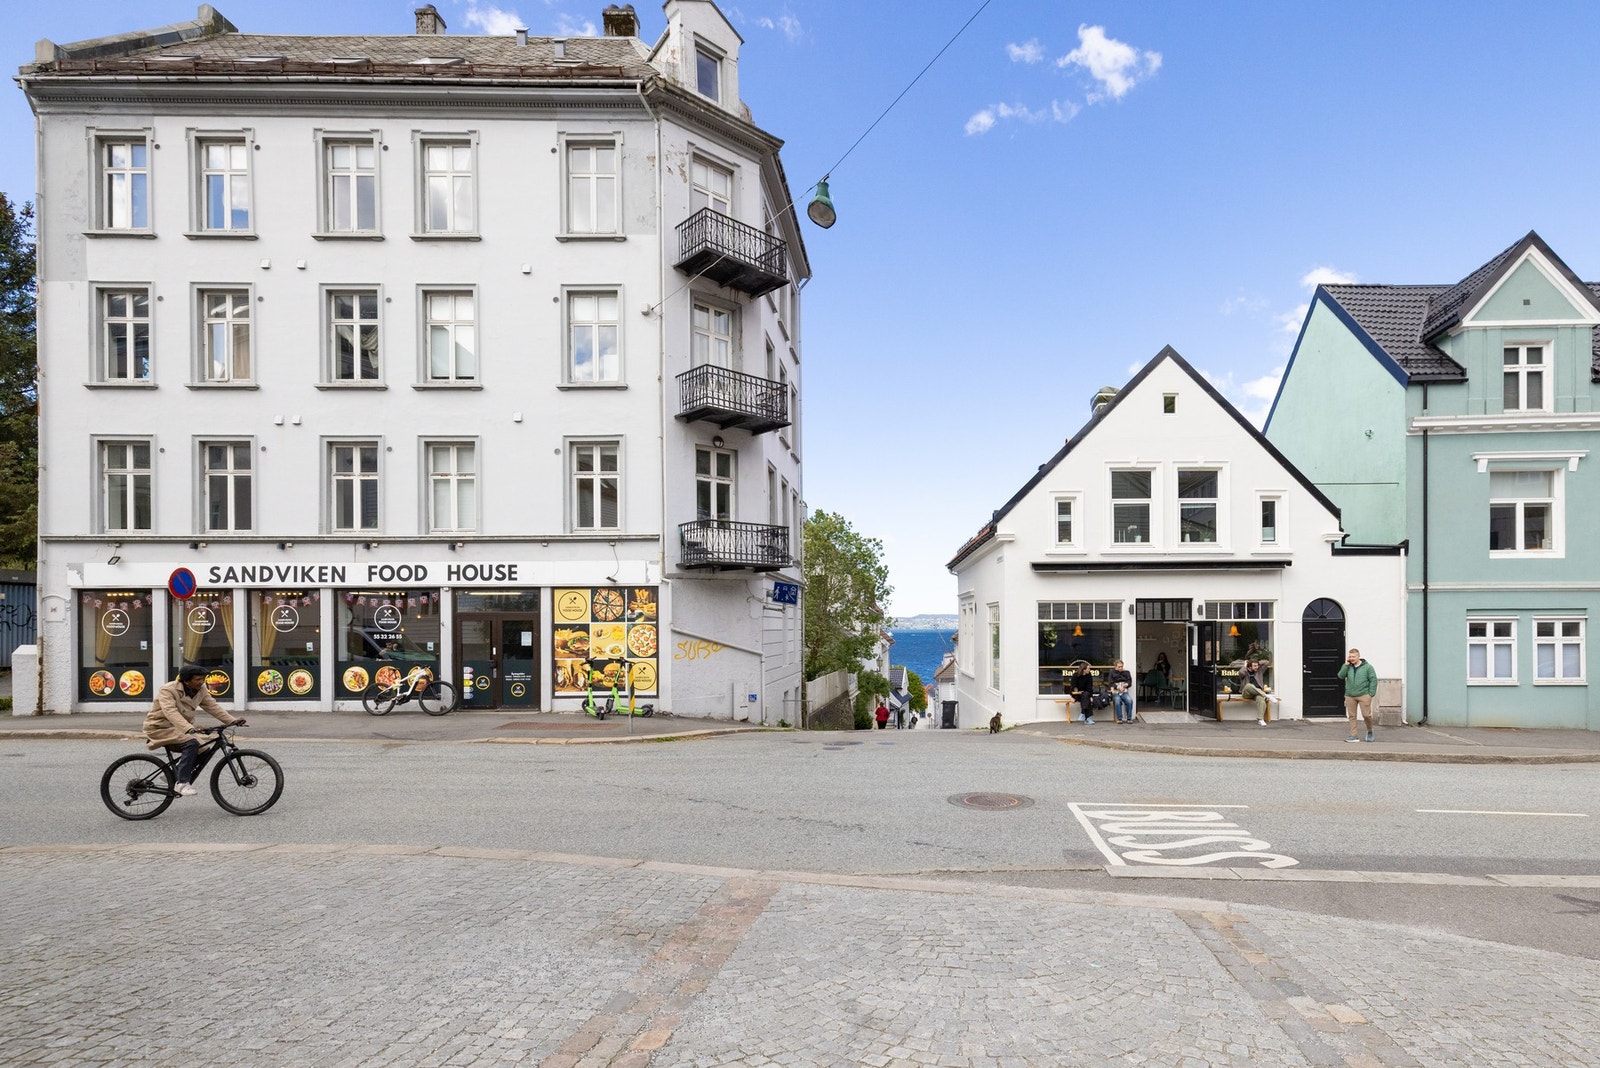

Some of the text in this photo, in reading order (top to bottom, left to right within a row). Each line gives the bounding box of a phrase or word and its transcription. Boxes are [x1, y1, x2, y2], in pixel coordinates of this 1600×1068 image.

[208, 564, 518, 583] SANDVIKEN FOOD HOUSE
[1084, 811, 1301, 869] BUSS
